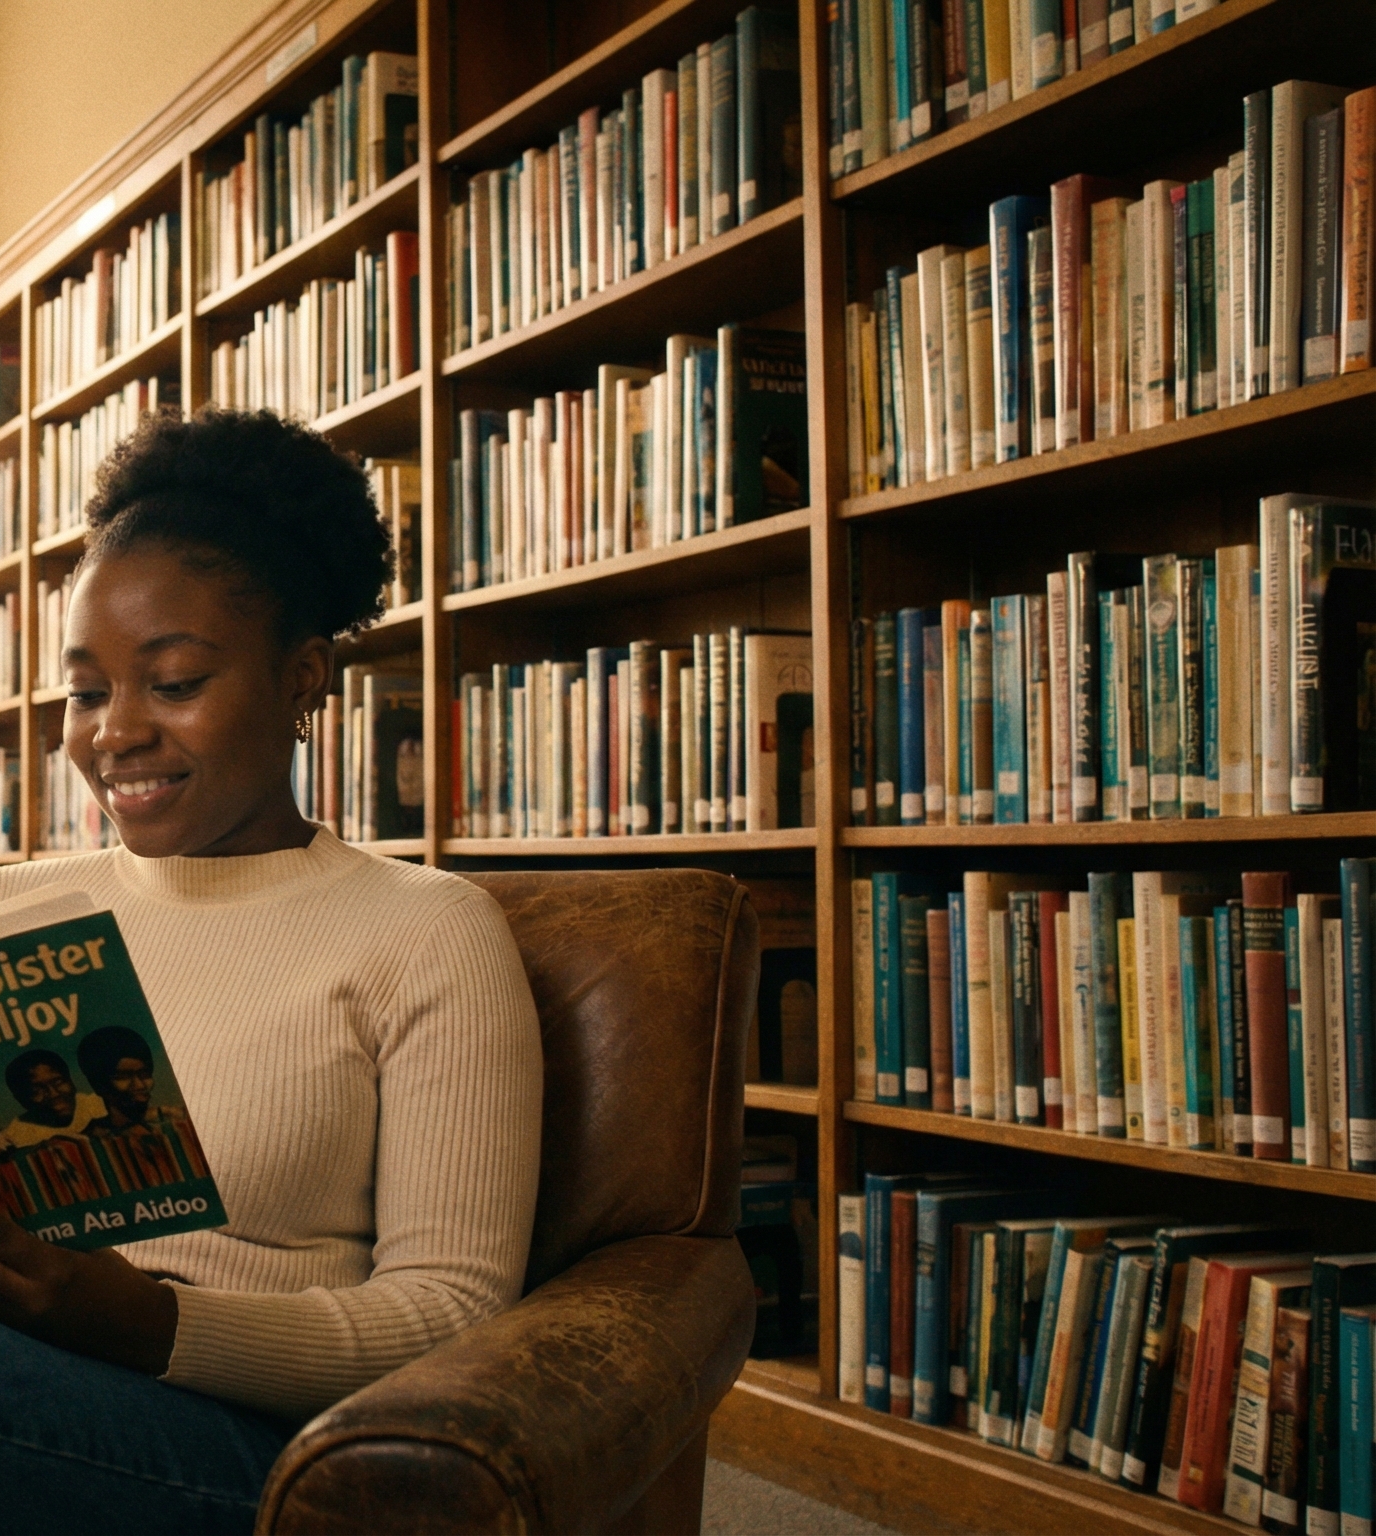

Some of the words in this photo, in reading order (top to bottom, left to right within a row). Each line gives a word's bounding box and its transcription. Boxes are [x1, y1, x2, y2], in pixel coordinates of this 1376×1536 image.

[28, 1222, 76, 1242] ma
[84, 1210, 126, 1233] Ata
[134, 1196, 209, 1224] Aidoo
